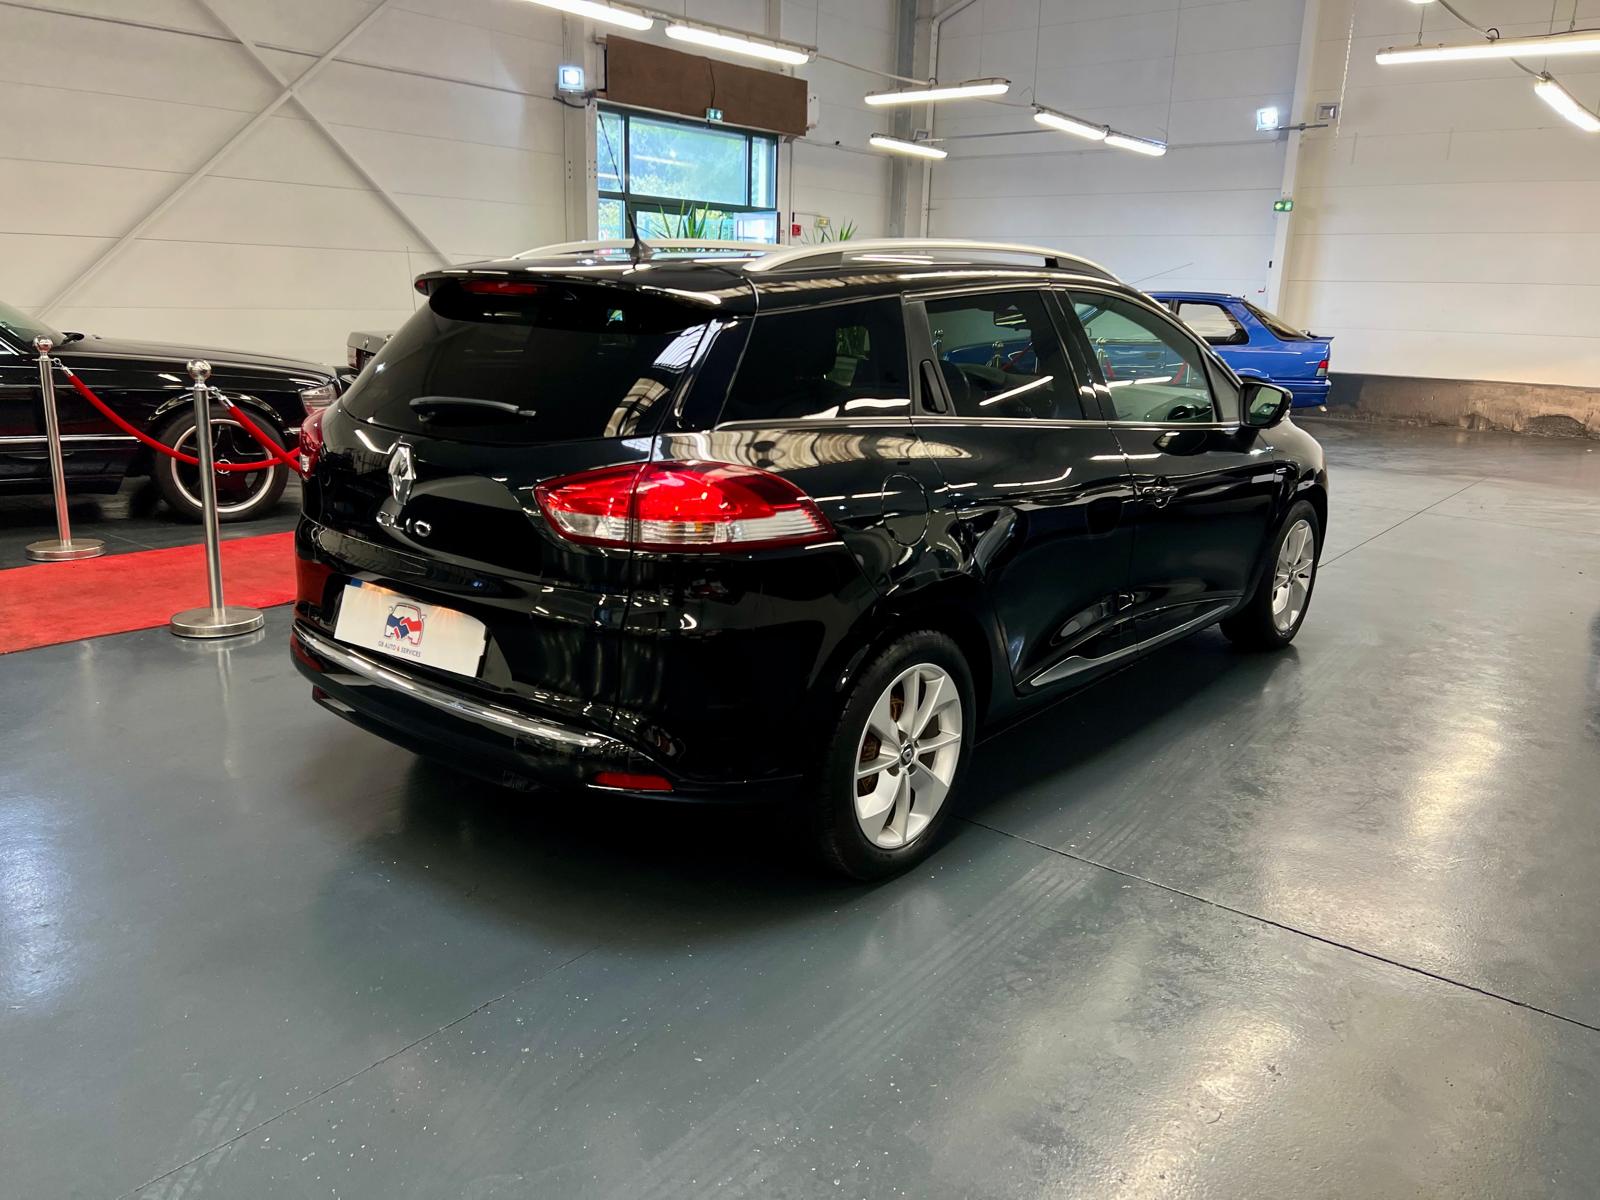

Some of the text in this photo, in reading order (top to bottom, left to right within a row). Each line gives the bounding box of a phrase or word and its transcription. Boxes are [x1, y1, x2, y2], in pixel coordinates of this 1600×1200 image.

[376, 511, 431, 537] CLIO
[384, 641, 397, 651] AUTO
[400, 646, 422, 658] SERVICES
